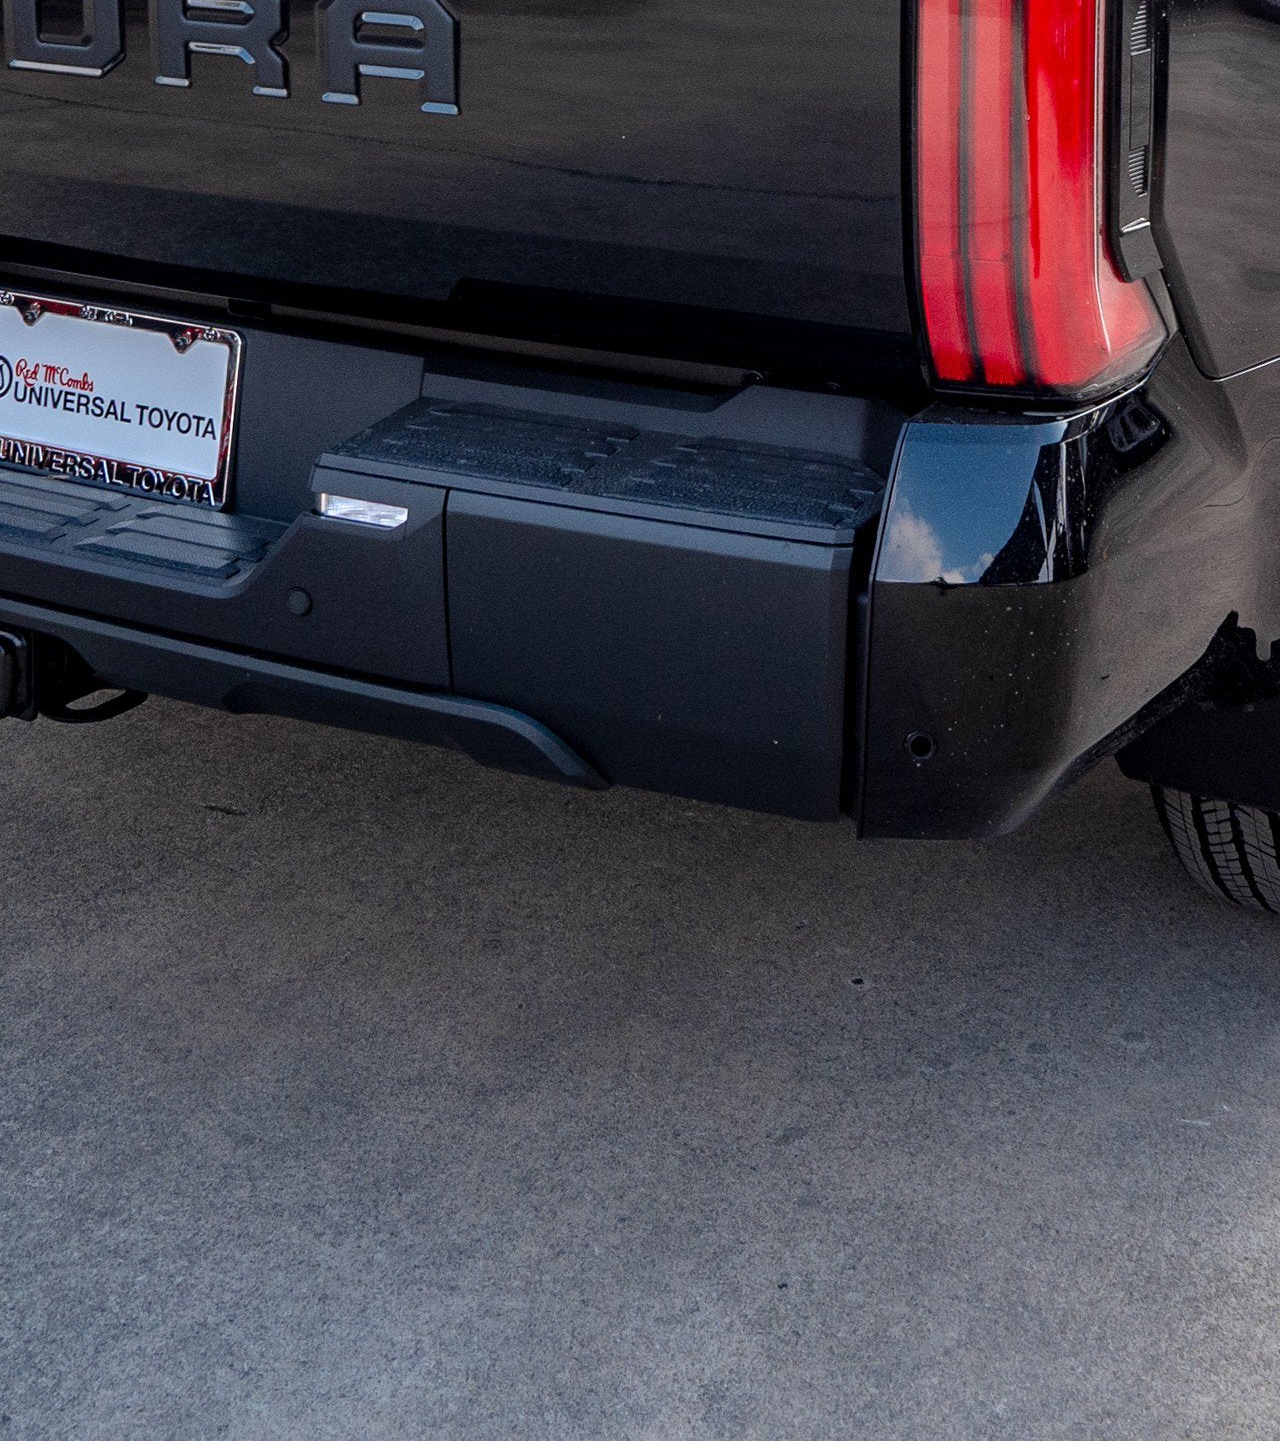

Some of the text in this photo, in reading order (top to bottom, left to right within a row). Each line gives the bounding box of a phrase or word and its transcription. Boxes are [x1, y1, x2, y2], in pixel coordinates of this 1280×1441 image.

[15, 358, 94, 392] Red McCombs
[13, 381, 218, 441] UNIVERSAL TOYOTA
[126, 466, 216, 507] TOYOTA
